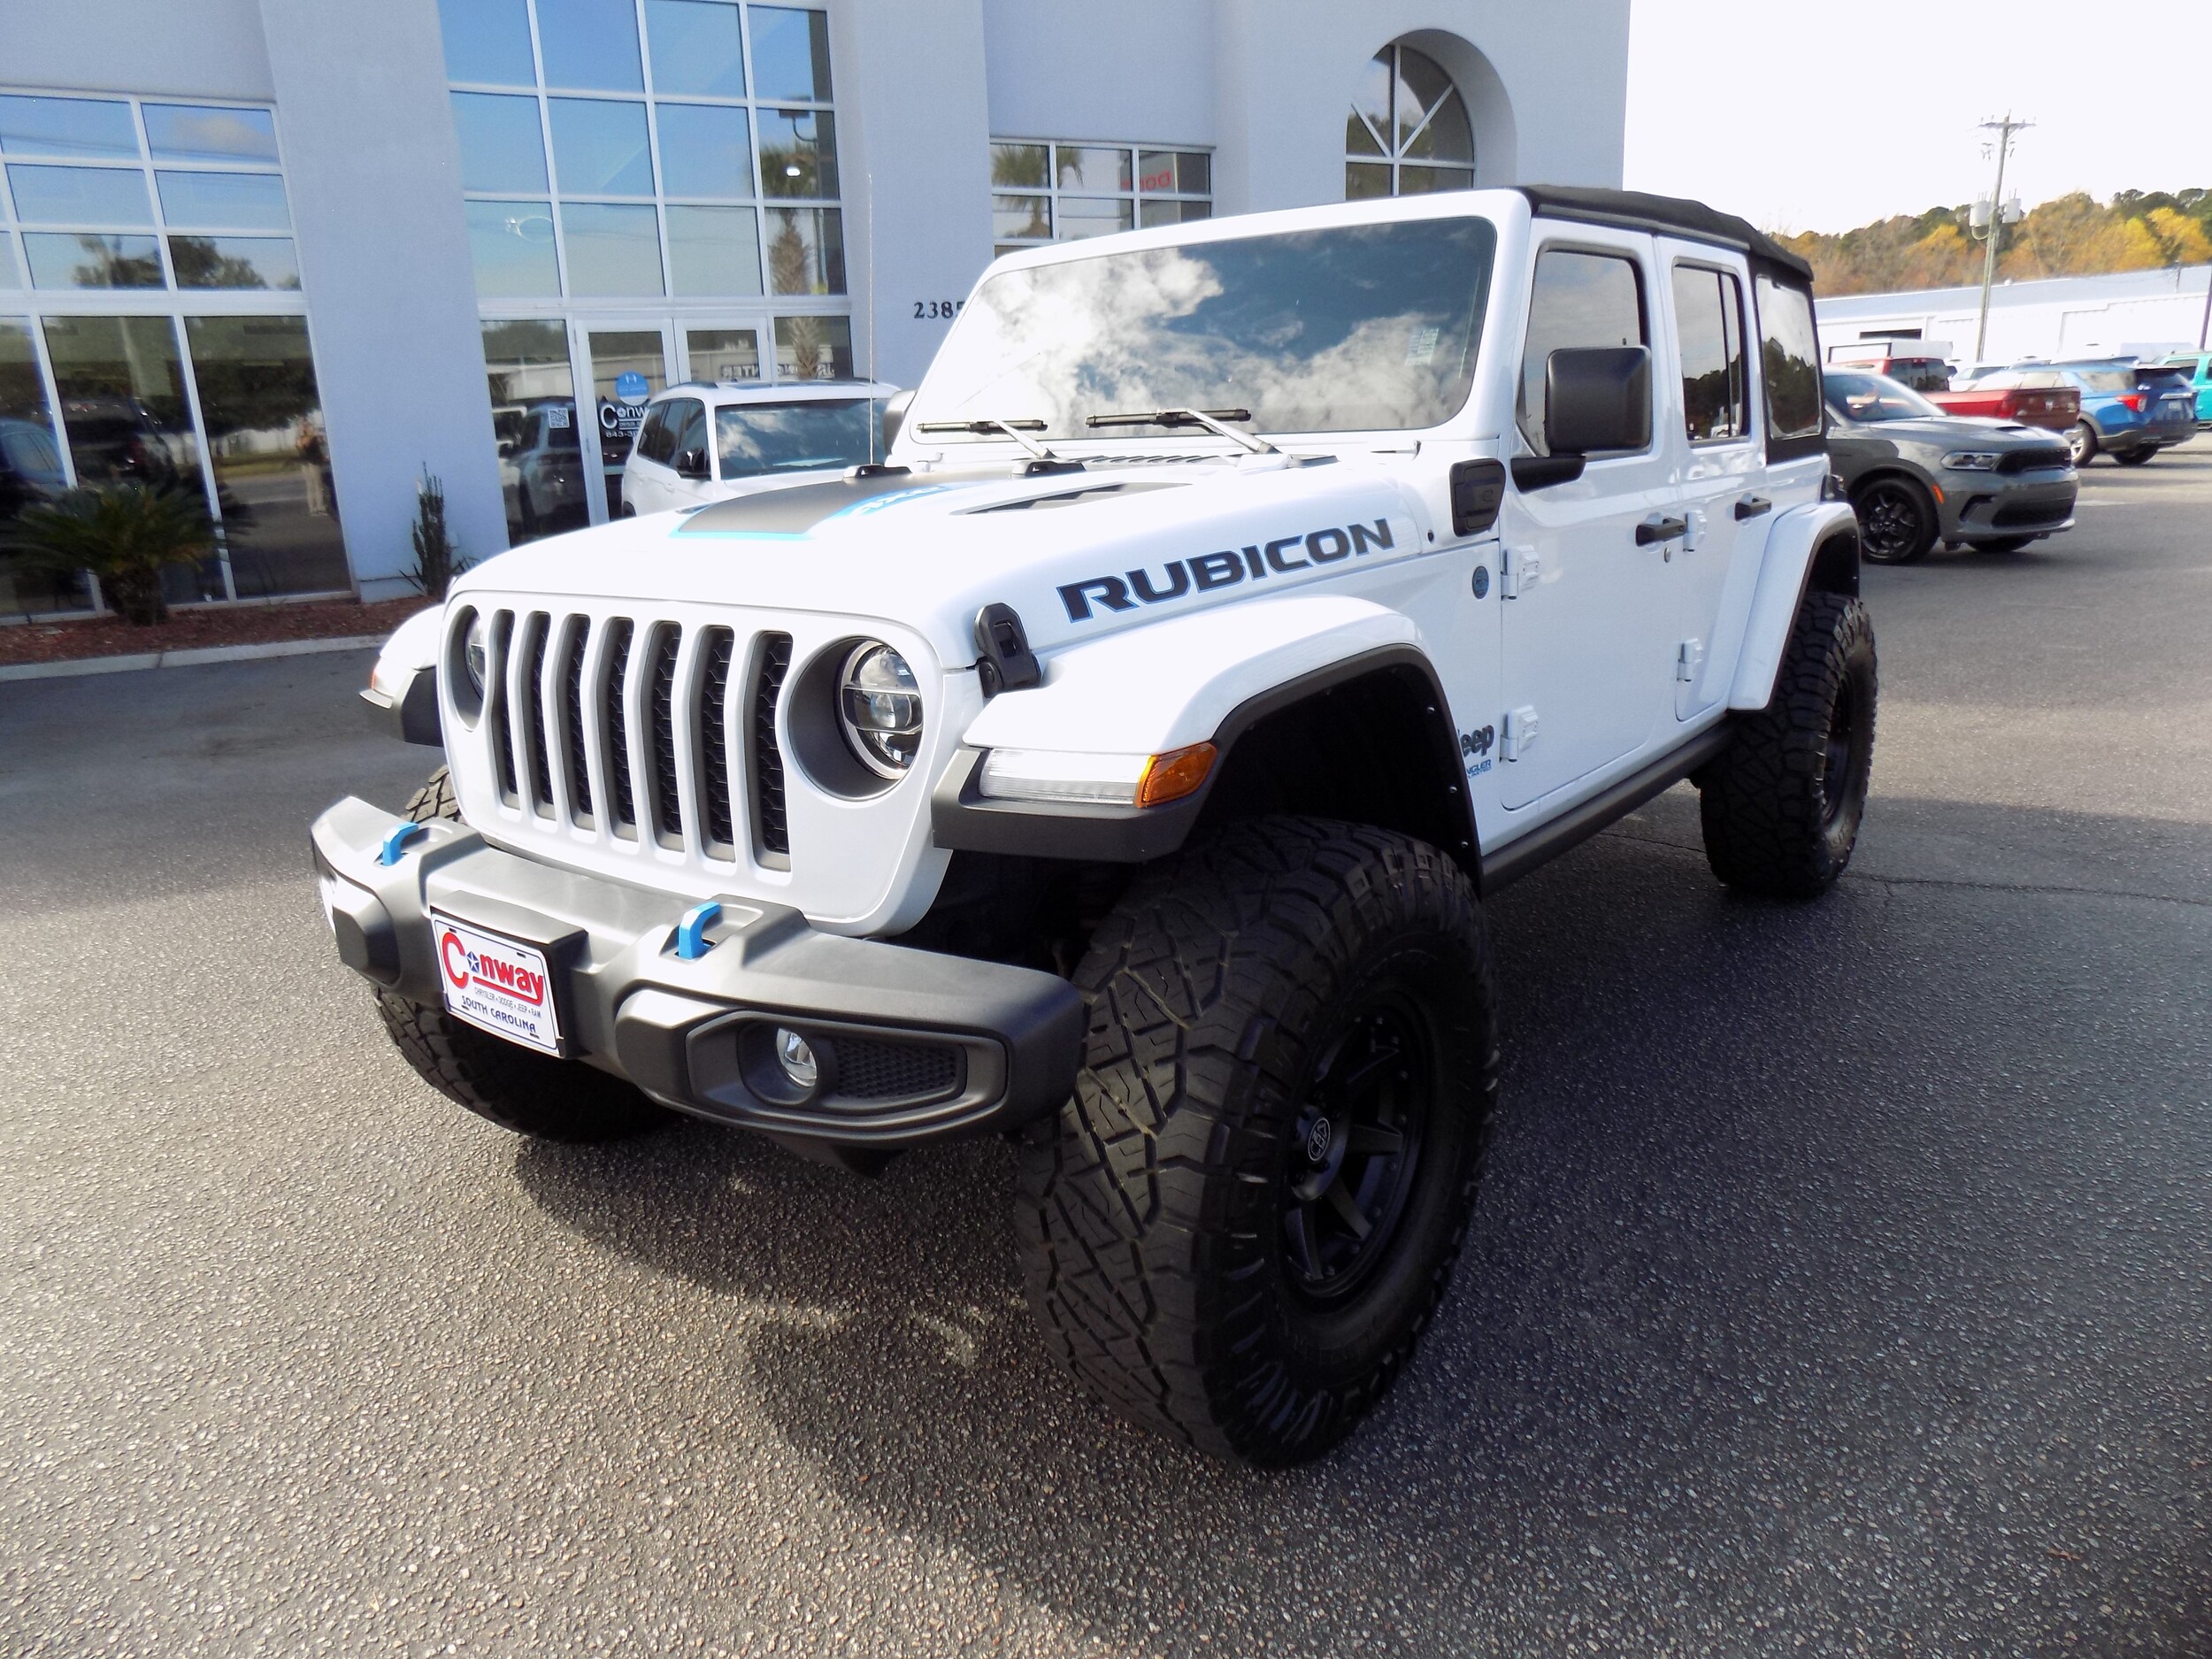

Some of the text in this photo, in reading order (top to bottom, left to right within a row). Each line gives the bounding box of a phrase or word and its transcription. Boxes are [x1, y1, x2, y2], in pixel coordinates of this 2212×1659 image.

[600, 404, 647, 429] Conw
[1056, 517, 1395, 624] RUBICON
[1458, 725, 1494, 758] eep
[1466, 759, 1492, 775] NGLER
[442, 932, 545, 1006] Conway
[461, 995, 537, 1033] SOUTH CAROLINA
